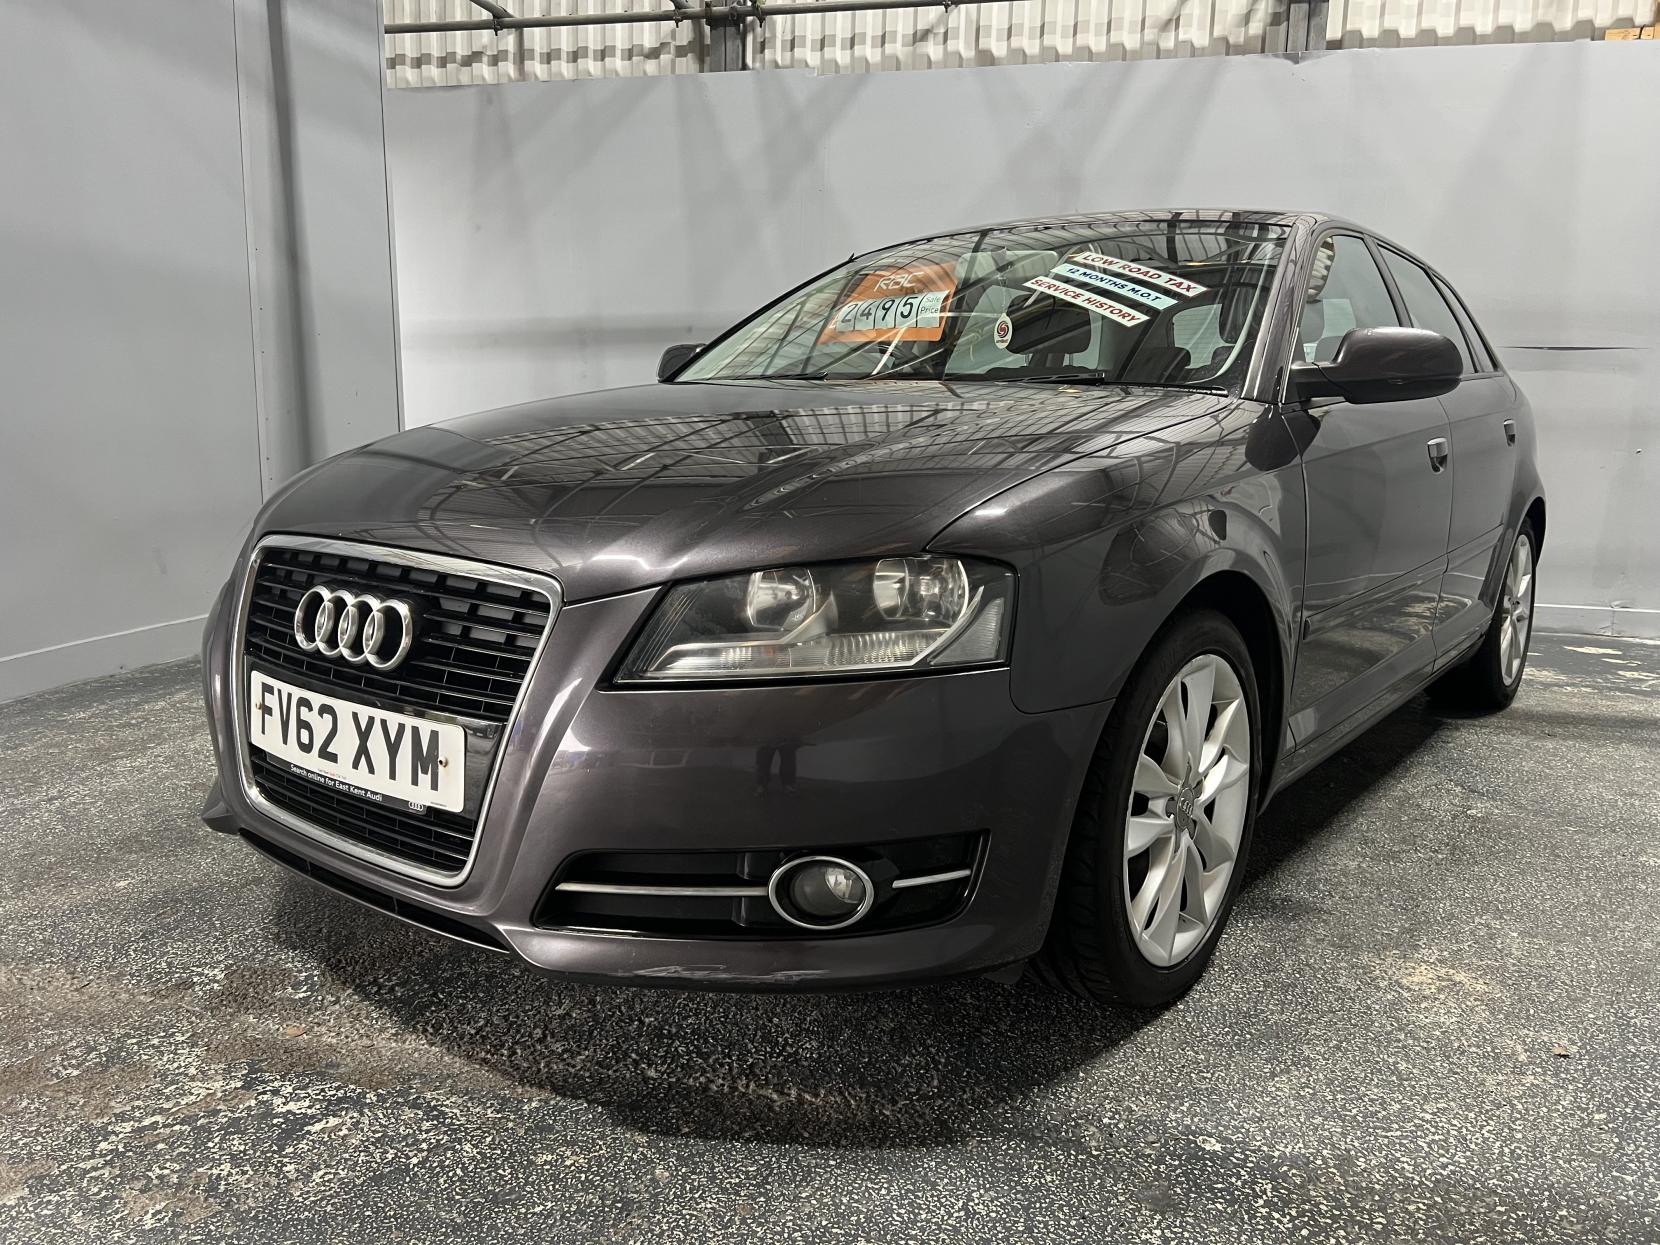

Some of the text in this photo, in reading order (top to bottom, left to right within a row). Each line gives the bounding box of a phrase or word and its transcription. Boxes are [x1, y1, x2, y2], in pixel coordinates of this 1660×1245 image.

[1066, 267, 1163, 302] 12 MONTHS M.O.T
[1082, 254, 1197, 293] LOW ROAD TAX
[920, 306, 939, 314] Price
[1031, 278, 1140, 323] SERVICE HISTORY
[261, 682, 440, 792] FV62 XYM
[290, 764, 307, 776] Search
[308, 772, 325, 783] online
[325, 776, 335, 786] for
[335, 780, 349, 791] East
[350, 786, 366, 796] Kent
[366, 791, 382, 801] Audi
